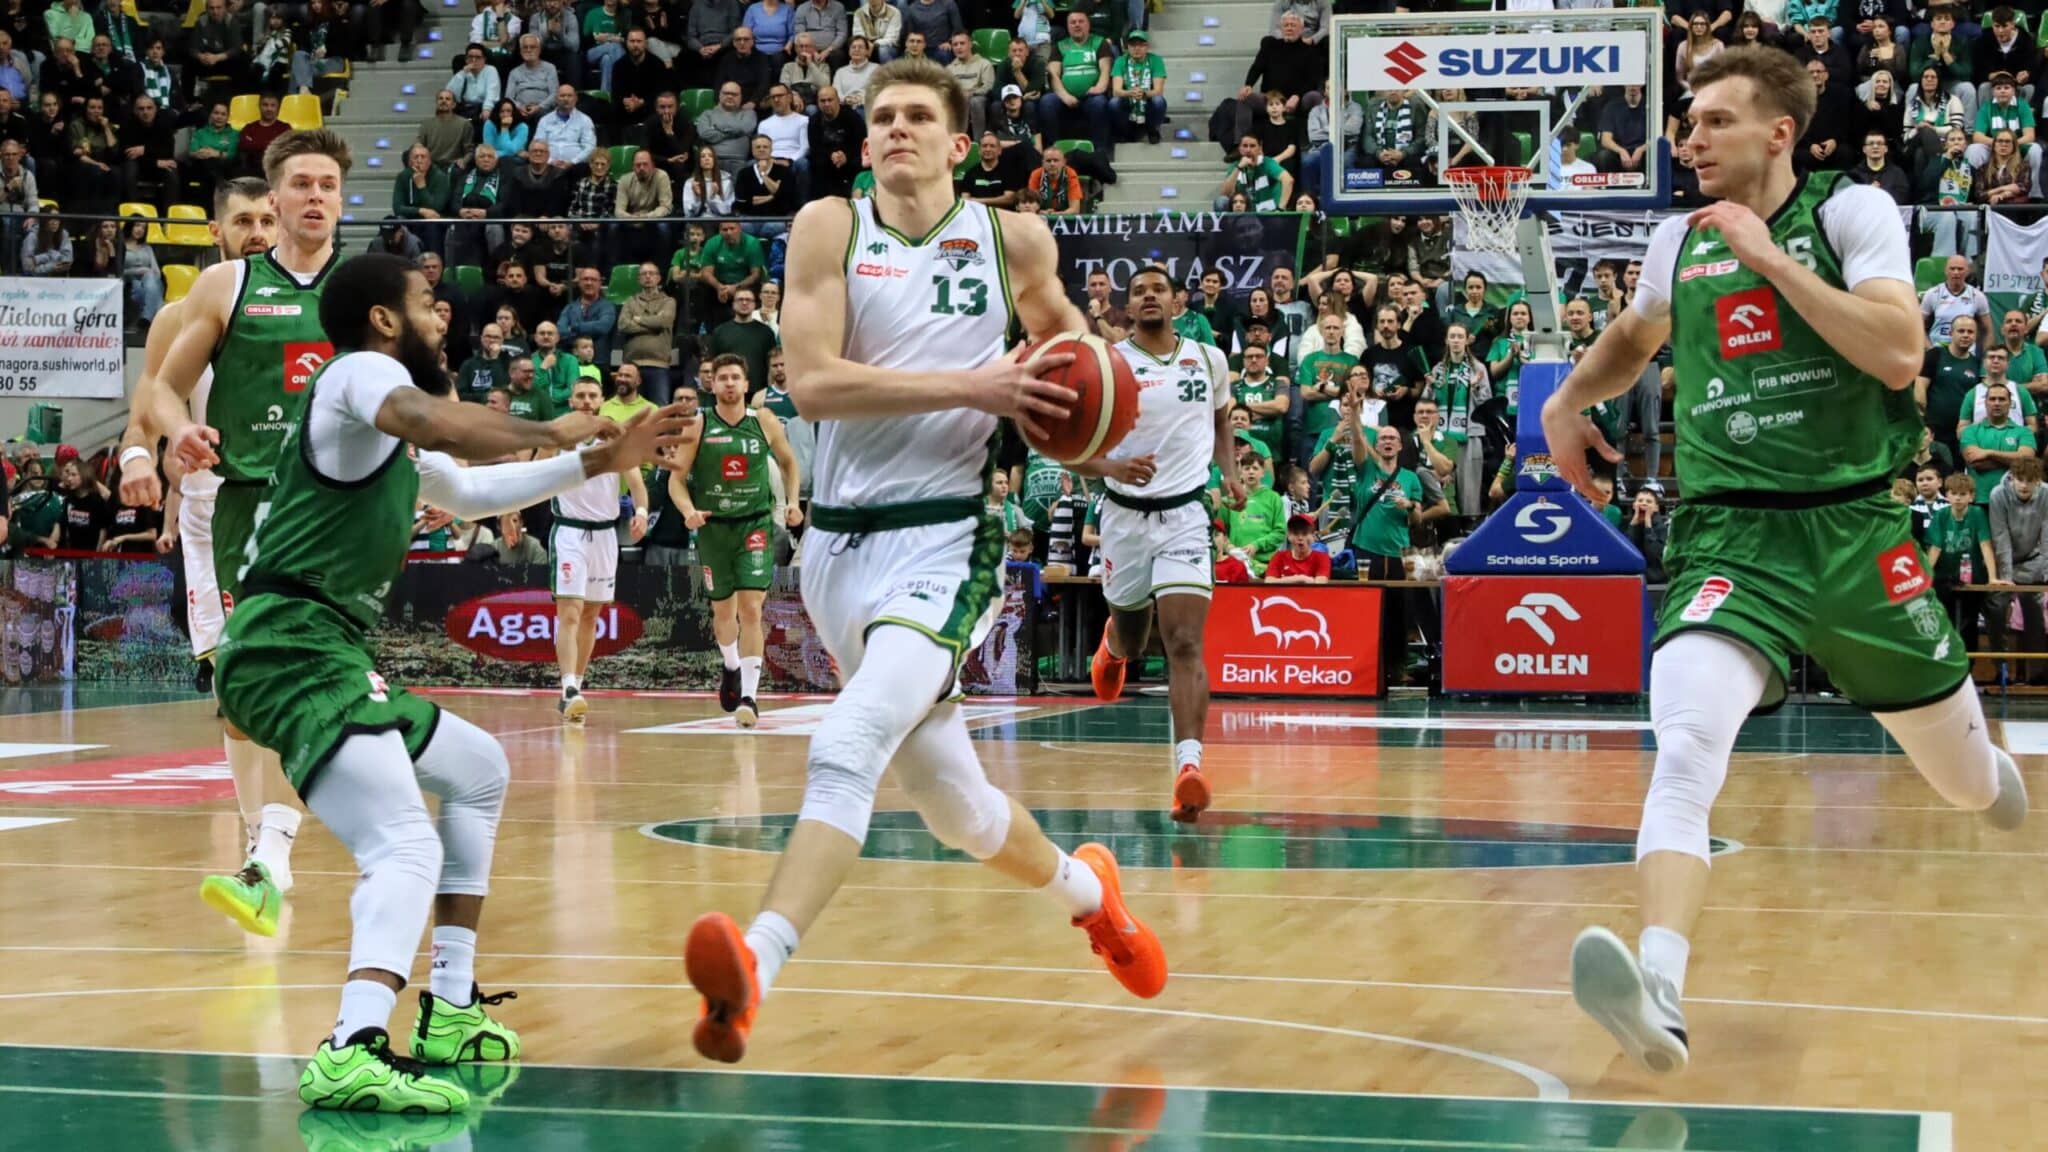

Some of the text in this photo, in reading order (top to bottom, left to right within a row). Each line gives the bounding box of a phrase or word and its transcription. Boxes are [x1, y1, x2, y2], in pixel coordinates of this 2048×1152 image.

[1438, 45, 1620, 77] SUZUKI
[1347, 170, 1380, 181] molten
[1574, 175, 1606, 185] ORLEN
[931, 275, 988, 316] 13
[0, 304, 119, 333] Zielona Góra
[1727, 330, 1772, 348] ORLEN
[19, 376, 37, 391] 55
[1757, 367, 1832, 390] PIB NOWUM
[1177, 379, 1207, 402] 32
[1690, 392, 1752, 417] MTMNOWUM
[1758, 409, 1804, 427] PP DOM
[740, 439, 760, 454] 12
[1486, 553, 1600, 567] Schelde Sports
[1893, 576, 1924, 594] ORLEN
[1222, 663, 1353, 686] Bank Pekao
[1494, 653, 1589, 676] ORLEN
